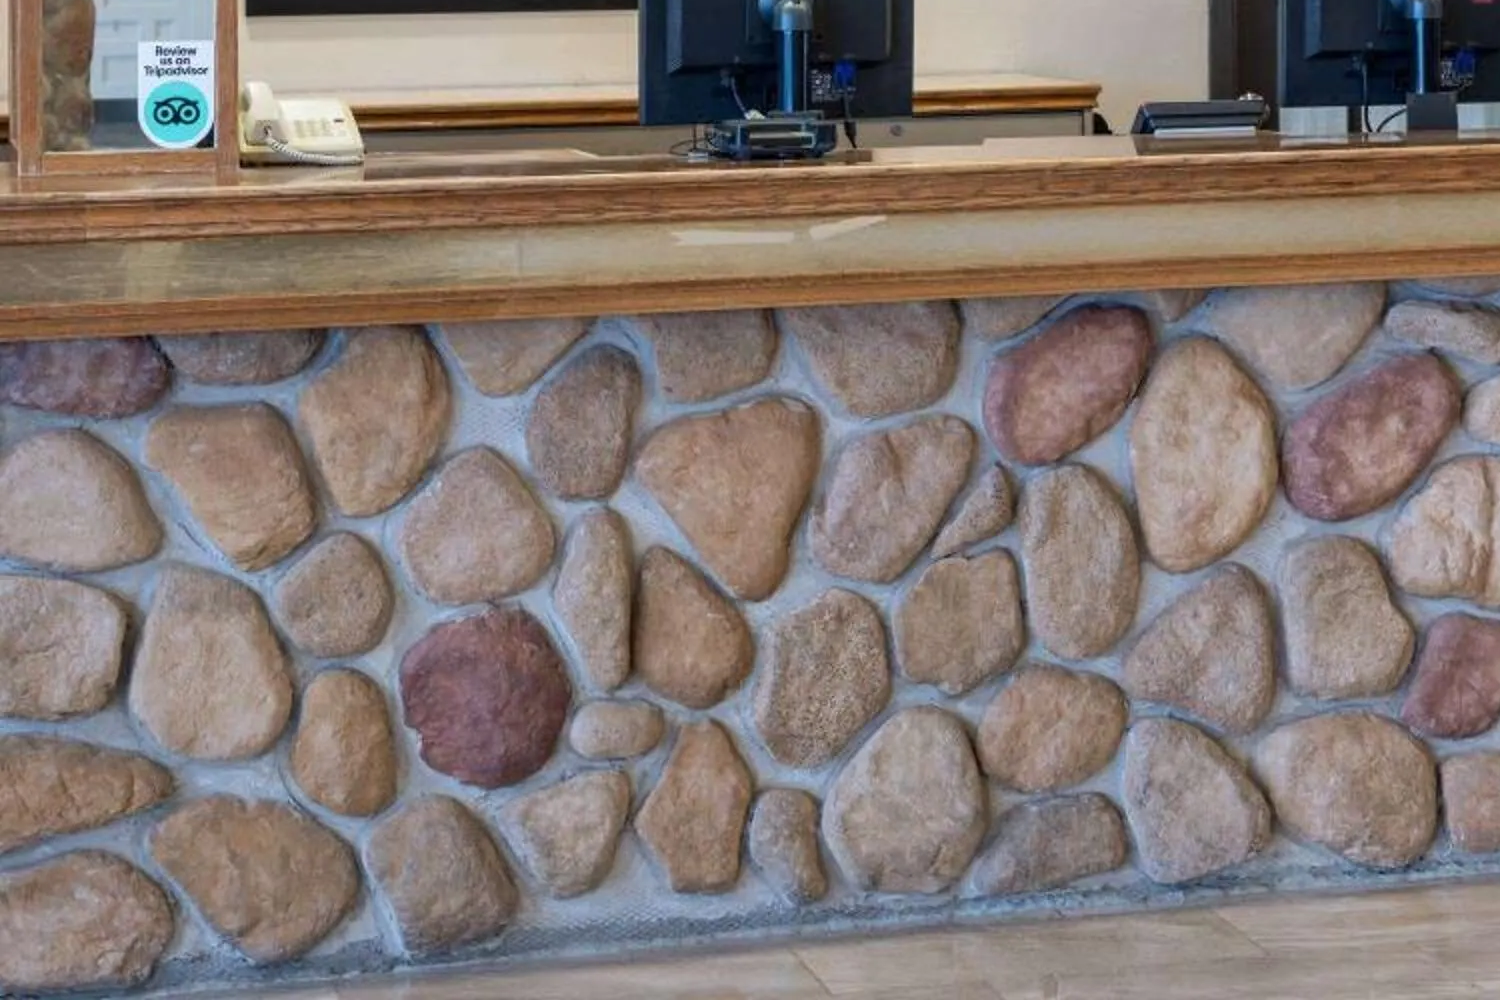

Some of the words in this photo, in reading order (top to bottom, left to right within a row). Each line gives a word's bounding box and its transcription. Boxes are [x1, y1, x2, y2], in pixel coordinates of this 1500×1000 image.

[155, 45, 196, 57] Review
[160, 57, 173, 65] us
[176, 57, 190, 65] on
[143, 66, 208, 78] Tripadvisor
